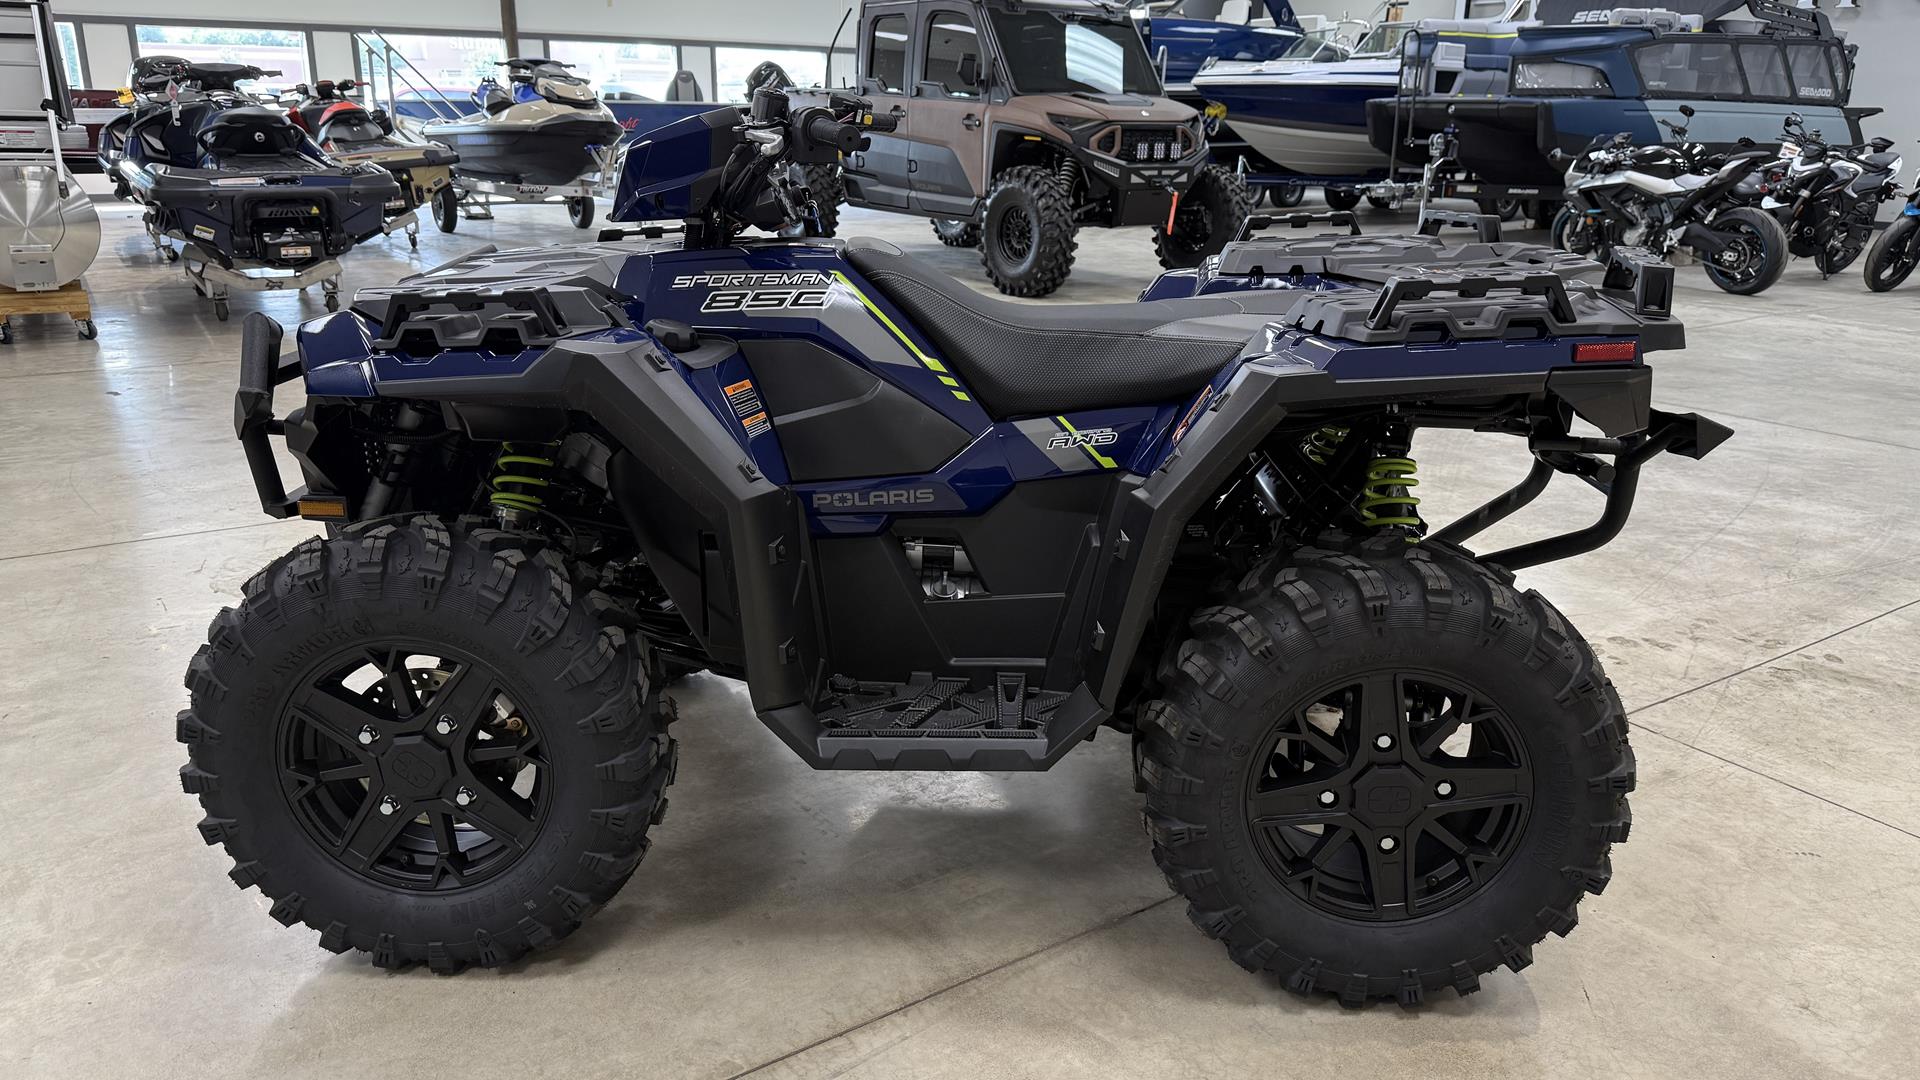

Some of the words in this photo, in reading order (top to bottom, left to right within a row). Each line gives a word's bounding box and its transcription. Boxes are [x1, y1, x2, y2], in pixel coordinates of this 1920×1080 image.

[671, 273, 836, 288] SPORTSMAN
[700, 289, 838, 313] 850
[1046, 432, 1118, 450] AWD
[812, 488, 935, 508] POLARIS
